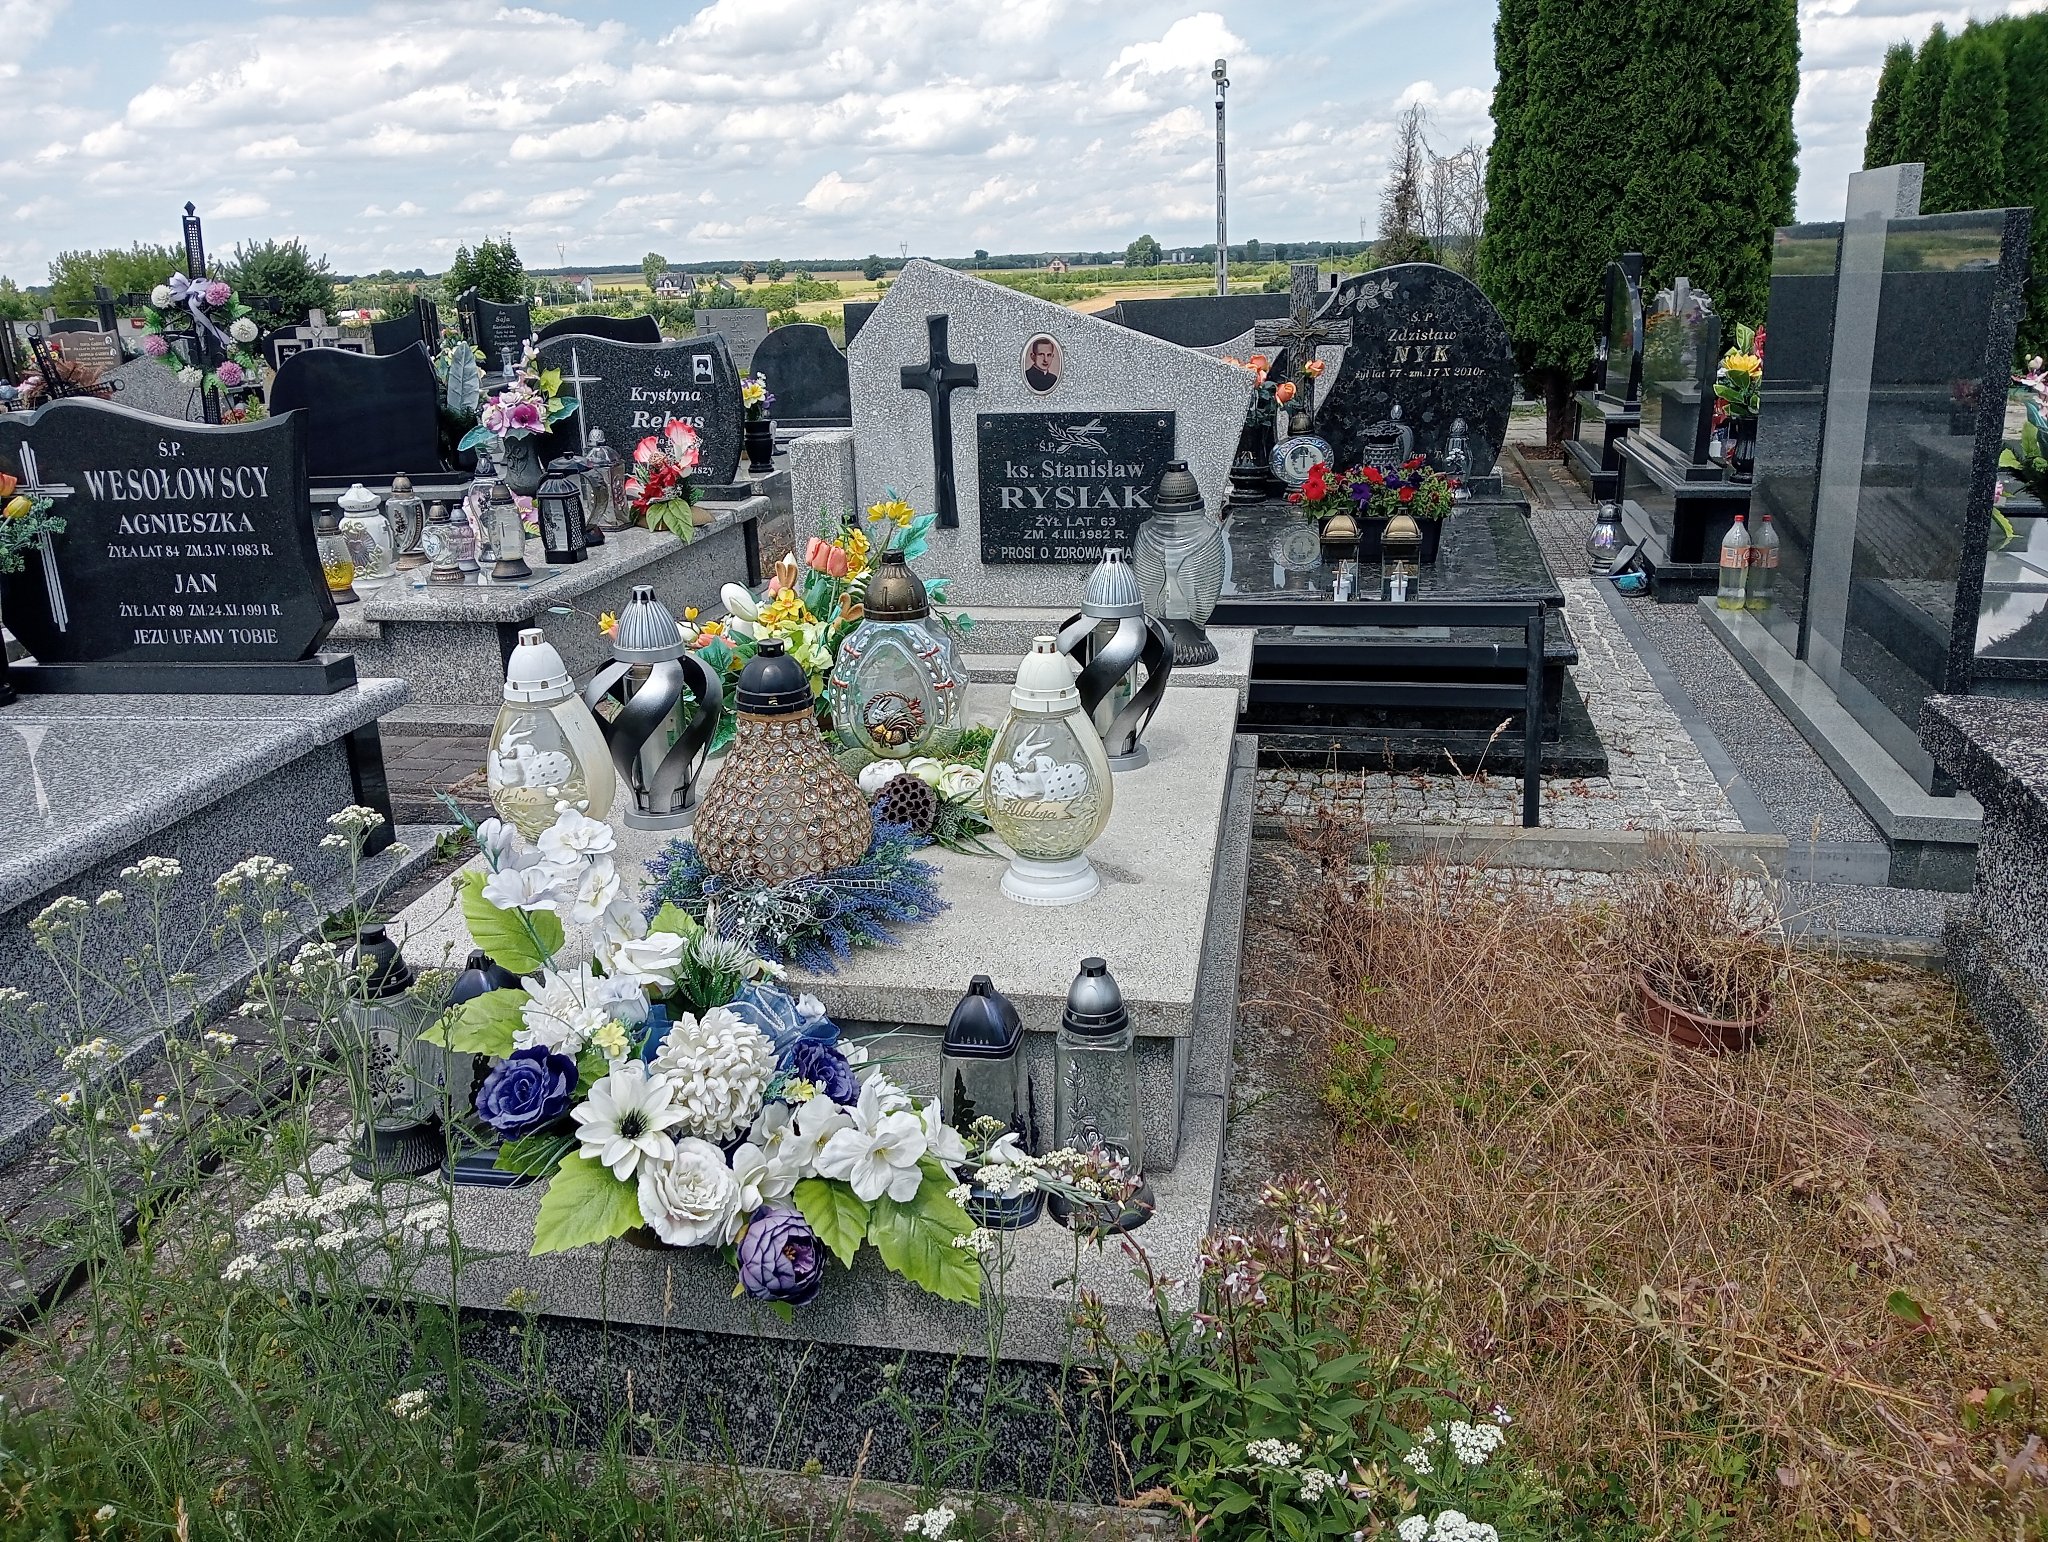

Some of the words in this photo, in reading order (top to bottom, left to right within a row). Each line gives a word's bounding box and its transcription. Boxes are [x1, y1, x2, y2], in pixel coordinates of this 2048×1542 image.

[1387, 327, 1457, 342] Zdzisław
[1391, 344, 1453, 364] NYK
[1389, 368, 1403, 378] 77
[1441, 367, 1452, 377] X
[630, 386, 702, 405] Krystyna
[158, 437, 185, 457] Ś.P.
[1006, 460, 1035, 479] ks.
[1041, 459, 1145, 479] Stanisław
[83, 465, 269, 501] WESOŁOWSCY
[999, 485, 1153, 509] RYSIAK
[118, 512, 256, 535] AGNIESZKA
[1035, 514, 1063, 527] ŻYŁ
[1066, 516, 1093, 527] LAT
[1100, 516, 1117, 527] 63
[1023, 529, 1048, 540] ZM.
[1114, 529, 1129, 540] R.
[107, 542, 138, 558] ŻYŁA
[139, 544, 163, 558] LAT
[165, 544, 180, 557] 84
[260, 543, 274, 556] R.
[1001, 546, 1036, 559] PROSI
[1040, 546, 1049, 559] O
[174, 573, 218, 594] JAN
[119, 601, 143, 617] ŻYŁ
[143, 604, 167, 617] LAT
[169, 604, 184, 617] 89
[271, 603, 283, 616] R.
[133, 628, 169, 645] JEZU
[171, 628, 225, 645] UFAMY
[228, 628, 279, 644] TOBIE
